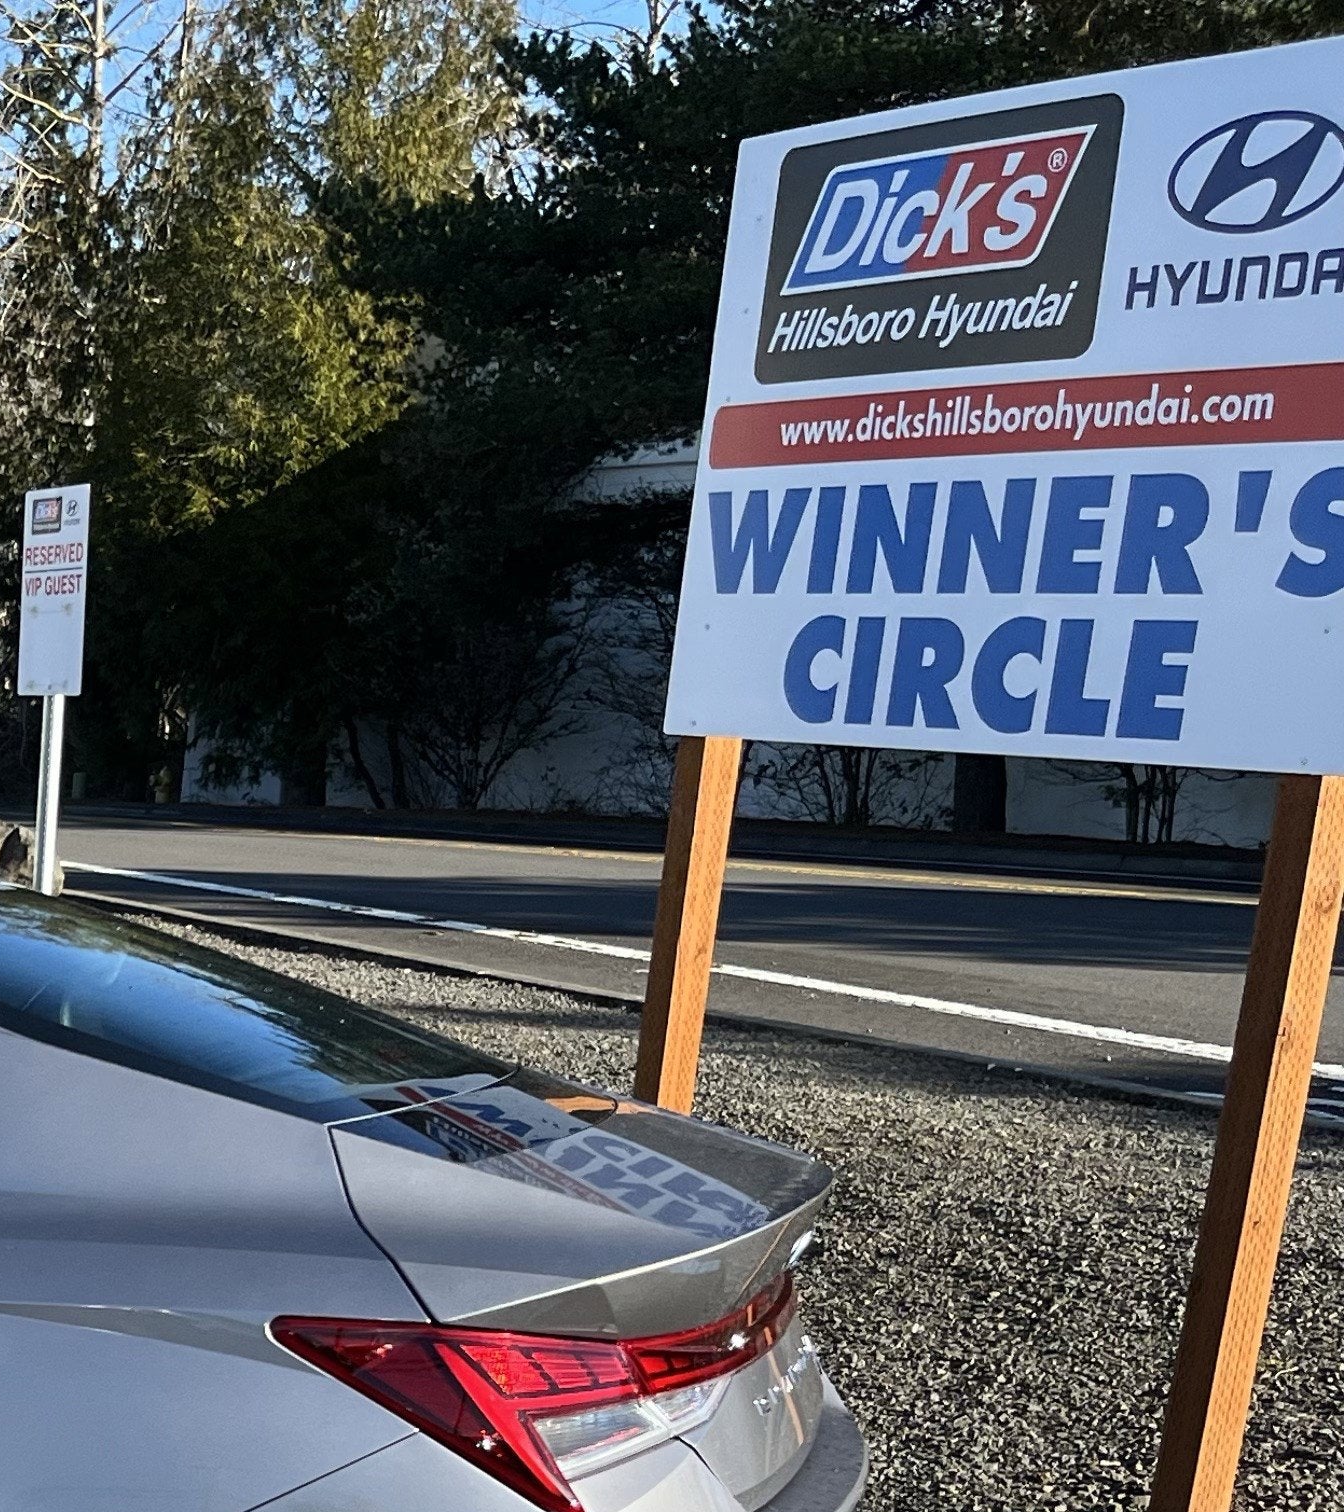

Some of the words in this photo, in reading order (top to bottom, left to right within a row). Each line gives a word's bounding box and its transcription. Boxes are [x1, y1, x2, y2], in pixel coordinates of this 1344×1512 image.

[767, 303, 917, 354] Hillsboro
[918, 279, 1079, 349] Hyundai
[779, 382, 1275, 447] www.dickshillsborohyundai.com
[25, 542, 84, 567] RESERVED
[708, 466, 1344, 598] WINNER'S
[25, 577, 42, 597] VIP
[45, 574, 83, 596] GUEST
[782, 614, 1200, 741] CIRCLE
